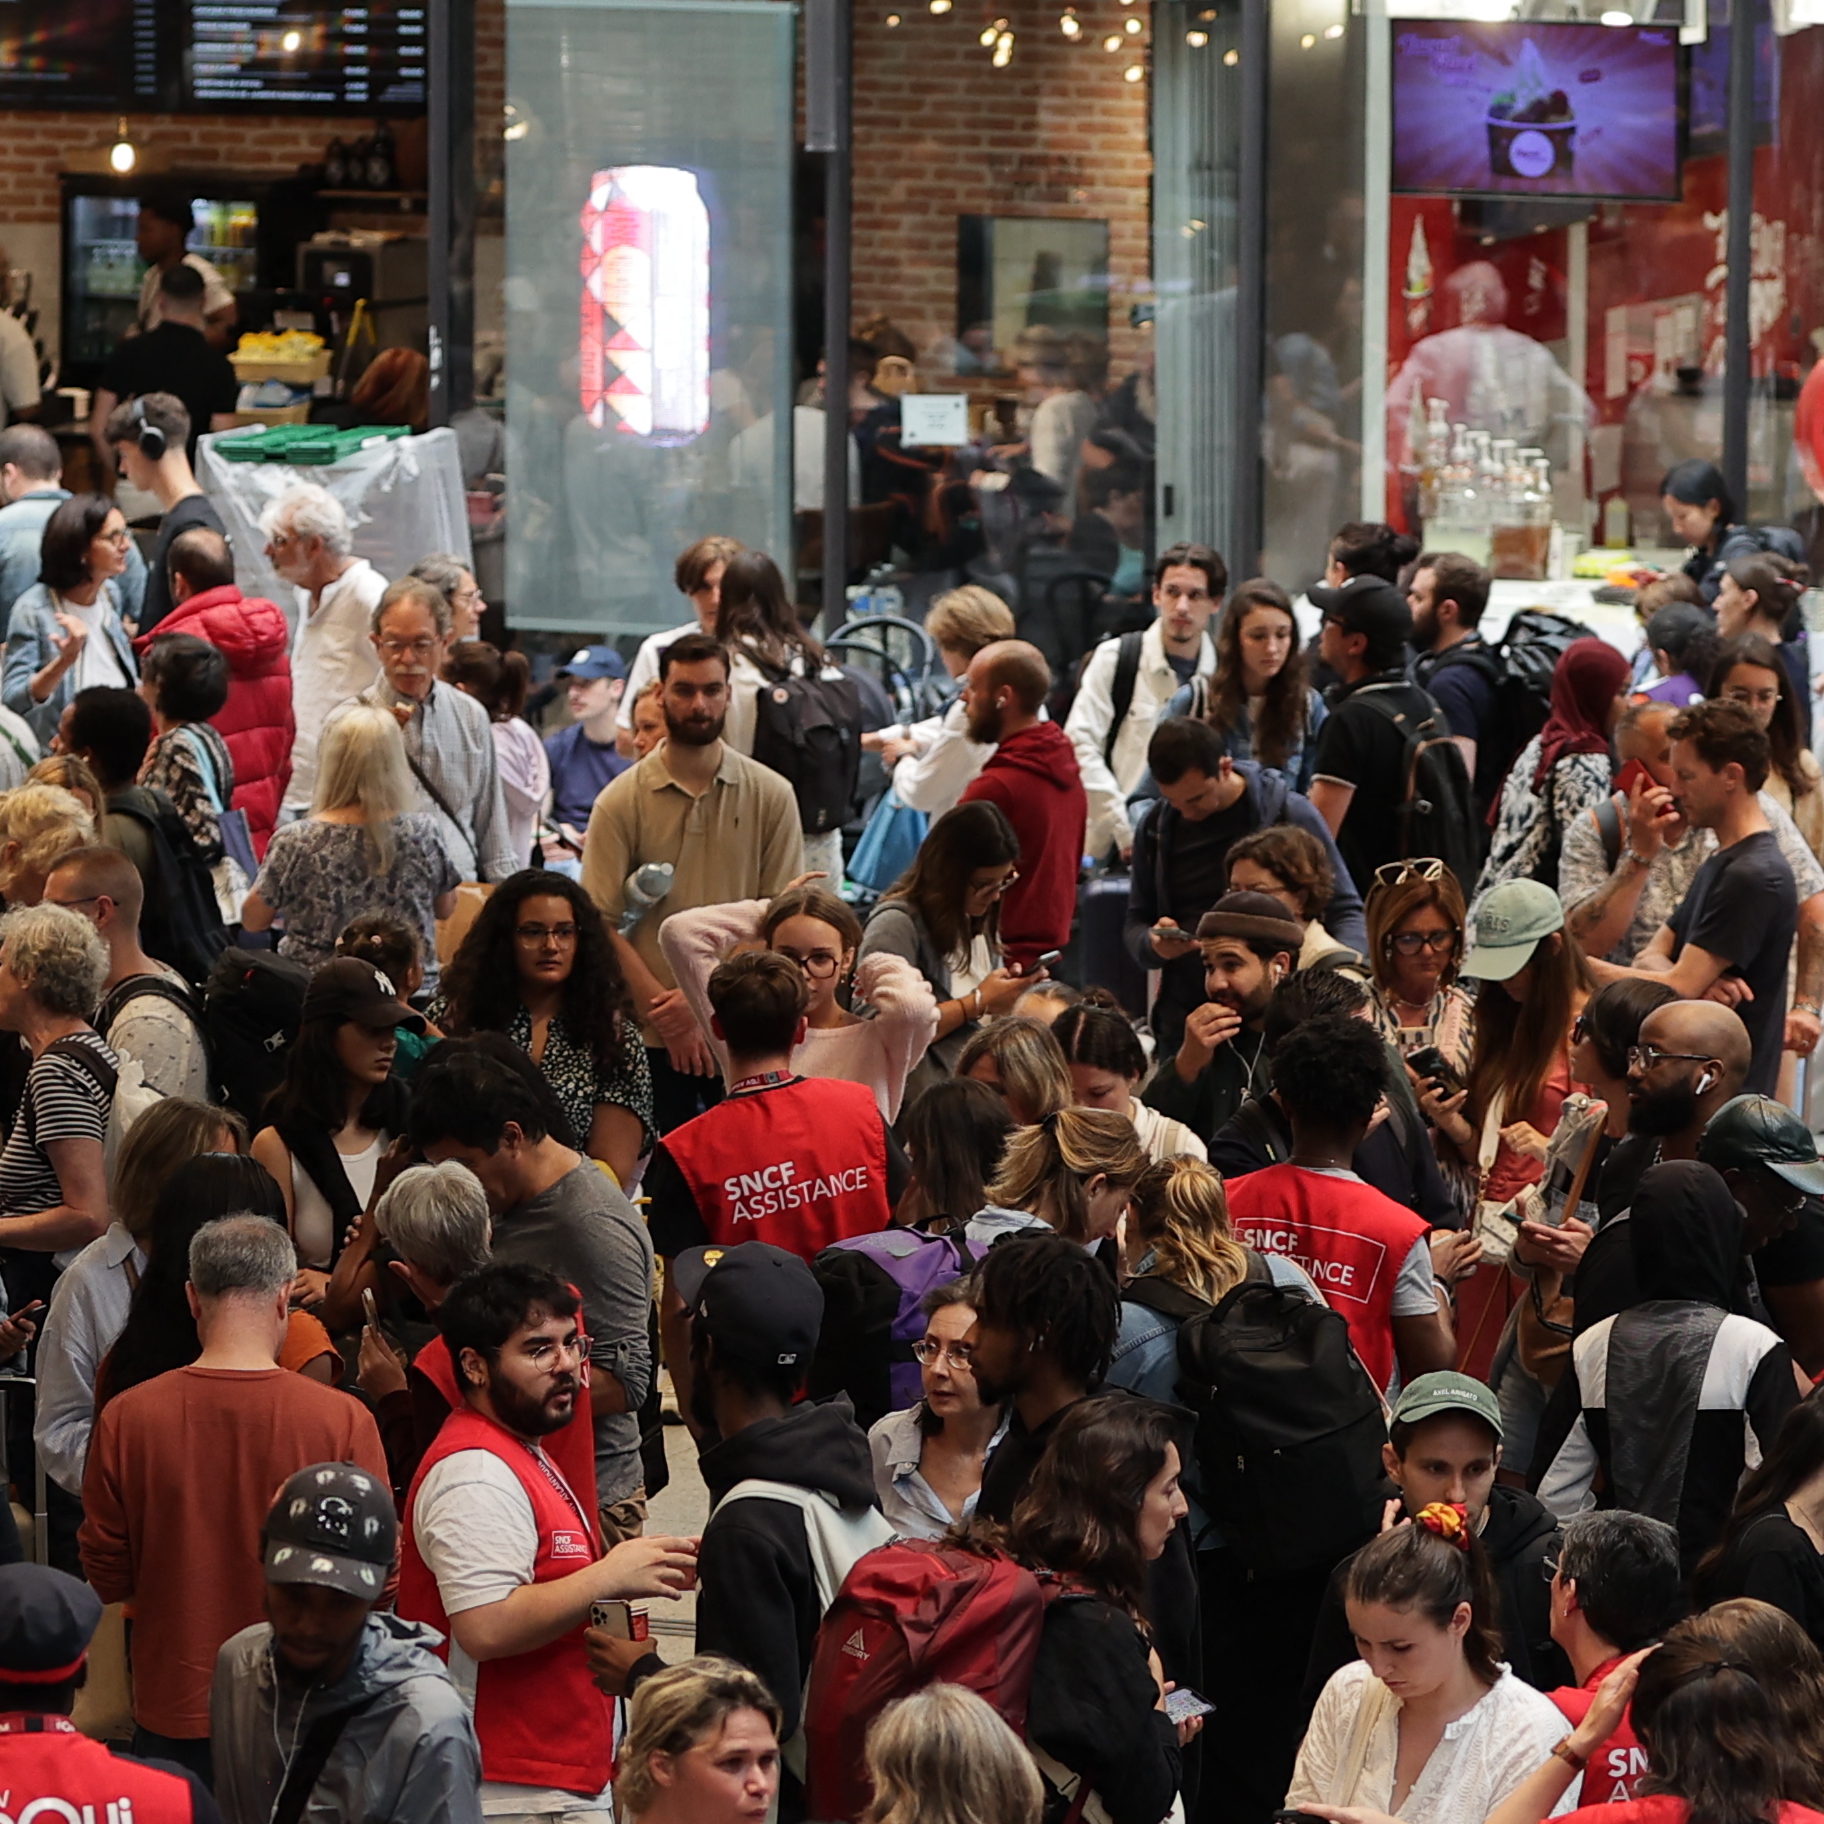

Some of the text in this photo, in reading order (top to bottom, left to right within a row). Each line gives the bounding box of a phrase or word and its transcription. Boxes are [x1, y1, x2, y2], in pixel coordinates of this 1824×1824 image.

[724, 1160, 797, 1201] SNCF
[732, 1165, 869, 1224] ASSISTANCE
[1243, 1228, 1299, 1252] SNCF
[554, 1535, 572, 1546] SNCF
